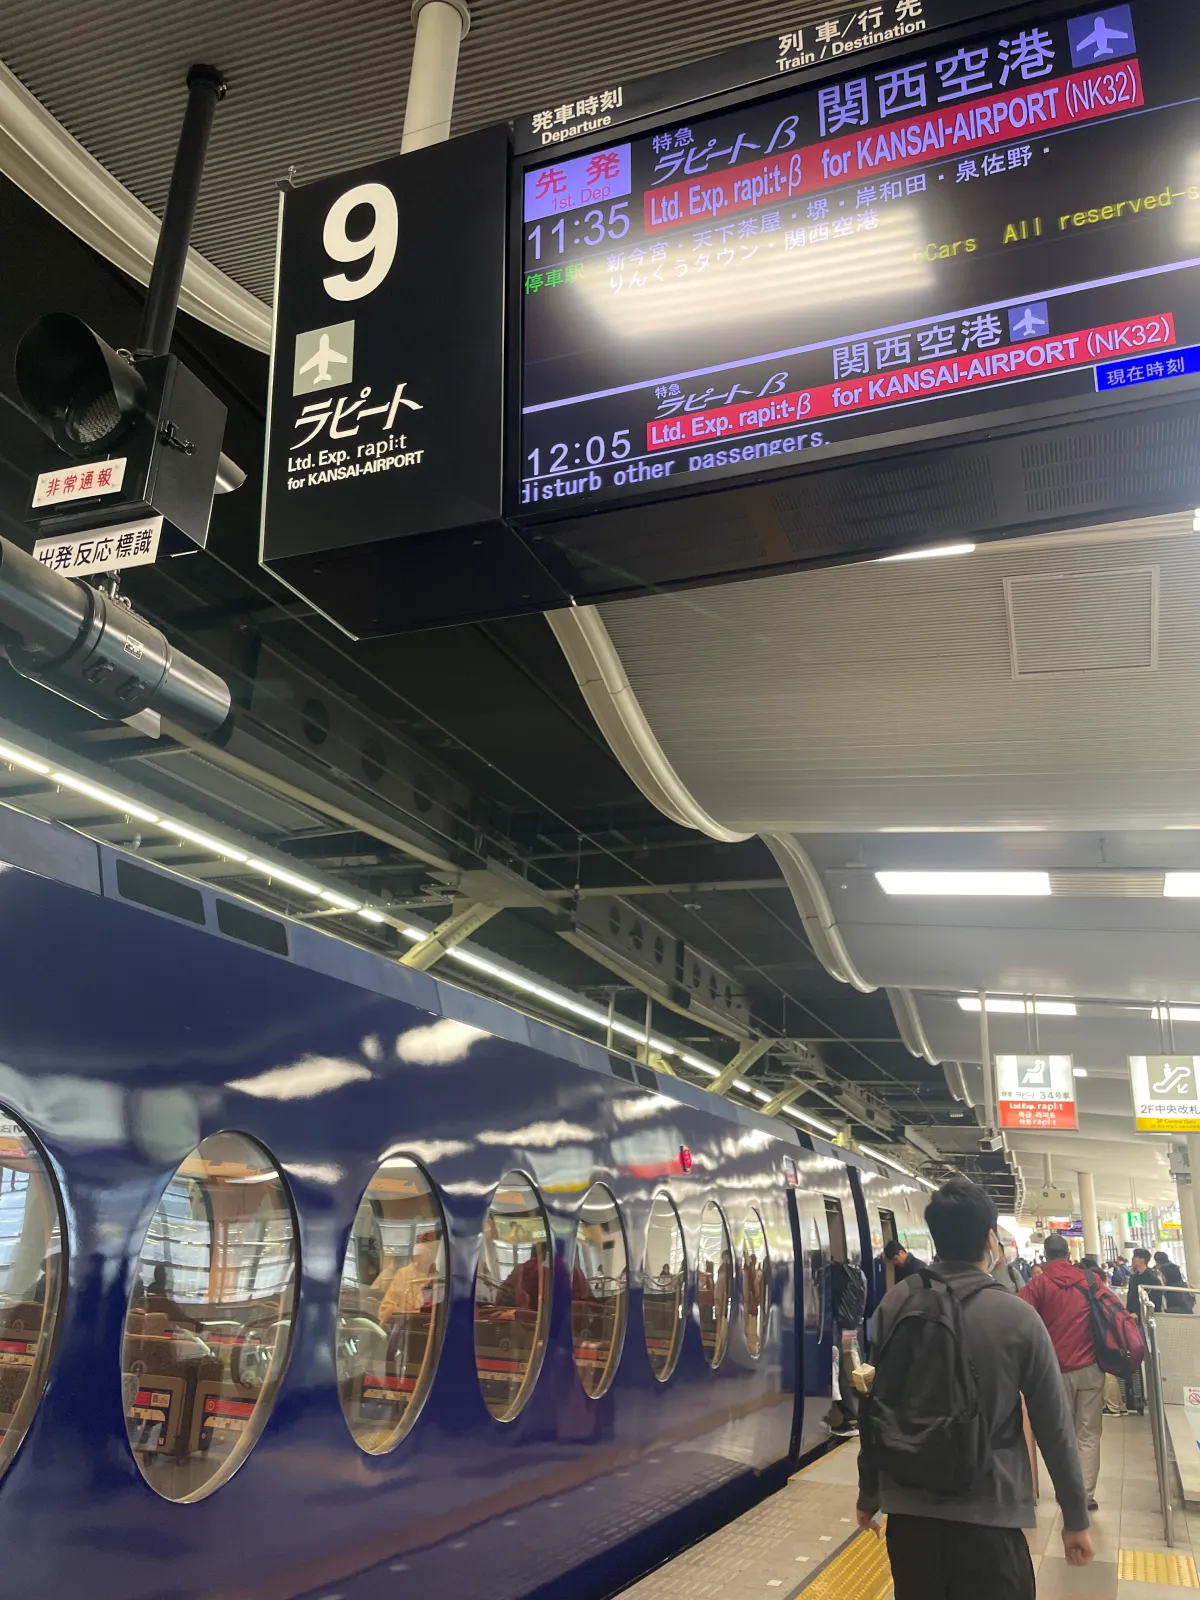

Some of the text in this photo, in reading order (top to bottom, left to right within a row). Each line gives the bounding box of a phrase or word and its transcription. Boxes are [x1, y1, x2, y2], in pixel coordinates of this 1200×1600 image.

[775, 52, 815, 72] Train
[831, 19, 926, 55] Destination
[818, 27, 1056, 138] 関西空港
[532, 86, 623, 134] 発車時刻
[541, 115, 611, 145] Departure
[651, 191, 684, 226] Ltd.
[688, 185, 728, 216] Exp.
[821, 148, 852, 180] for
[856, 88, 1059, 169] KANSAI-AIRPORT
[1065, 64, 1138, 118] (NK32)
[652, 127, 695, 154] 特急
[535, 151, 621, 200] 先発
[551, 184, 611, 212] 1st. Dep
[322, 182, 399, 302] 9
[527, 201, 630, 260] 11:35
[1003, 216, 1043, 244] All
[524, 262, 586, 295] 停車駅
[832, 313, 1003, 380] 関西空港
[651, 421, 686, 445] Ltd.
[691, 415, 733, 437] Exp.
[832, 386, 862, 408] for
[868, 337, 1080, 401] KANSAI-AIRPORT
[1086, 316, 1171, 358] (NK32)
[655, 383, 681, 399] 特急
[1106, 356, 1185, 386] 現在時刻
[289, 382, 424, 451] ラピート
[287, 434, 408, 473] Ltd. Exp. rapi:t
[287, 450, 425, 491] for KANSAI-AIRPORT
[527, 429, 631, 476] 12:05
[613, 459, 675, 486] other
[689, 429, 831, 472] passengers.
[45, 467, 113, 498] 非常通報
[38, 528, 153, 572] 出発反応標識
